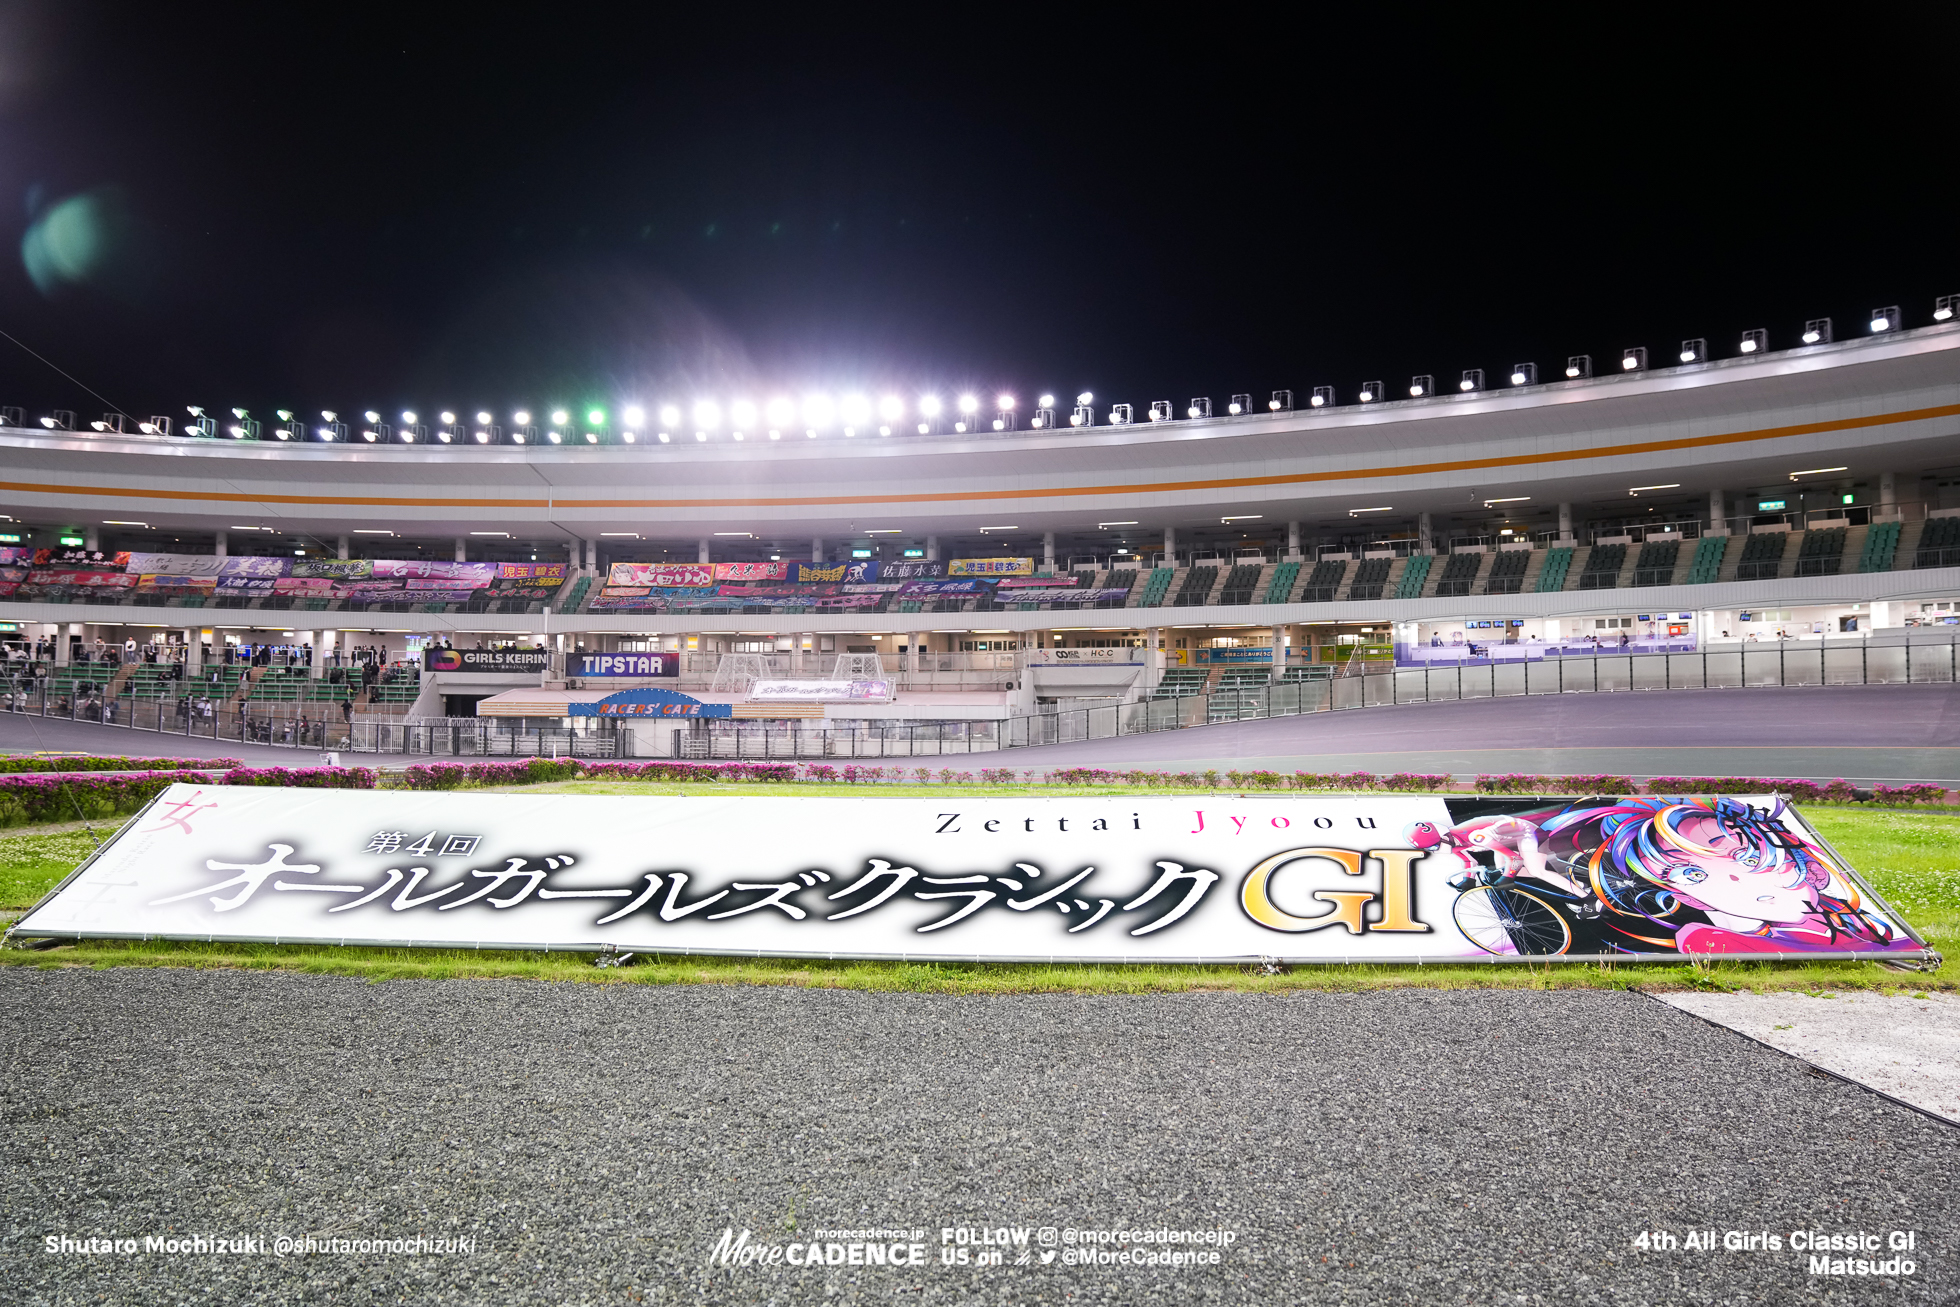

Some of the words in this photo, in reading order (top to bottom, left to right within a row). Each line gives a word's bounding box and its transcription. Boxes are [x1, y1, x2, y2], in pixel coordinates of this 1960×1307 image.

[504, 566, 561, 578] 児玉碧衣
[883, 564, 943, 578] 佐藤水菜
[464, 653, 503, 664] GIRLS
[506, 653, 547, 664] KEIRIN
[582, 656, 663, 674] TIPSTAR
[599, 702, 660, 714] RACERS'
[662, 704, 701, 715] GATE
[935, 811, 1142, 834] Zettai
[1190, 809, 1379, 836] Jyoou
[361, 830, 483, 857] 第4回
[148, 843, 1219, 936] オールガールズクラシック
[1240, 845, 1431, 936] GI
